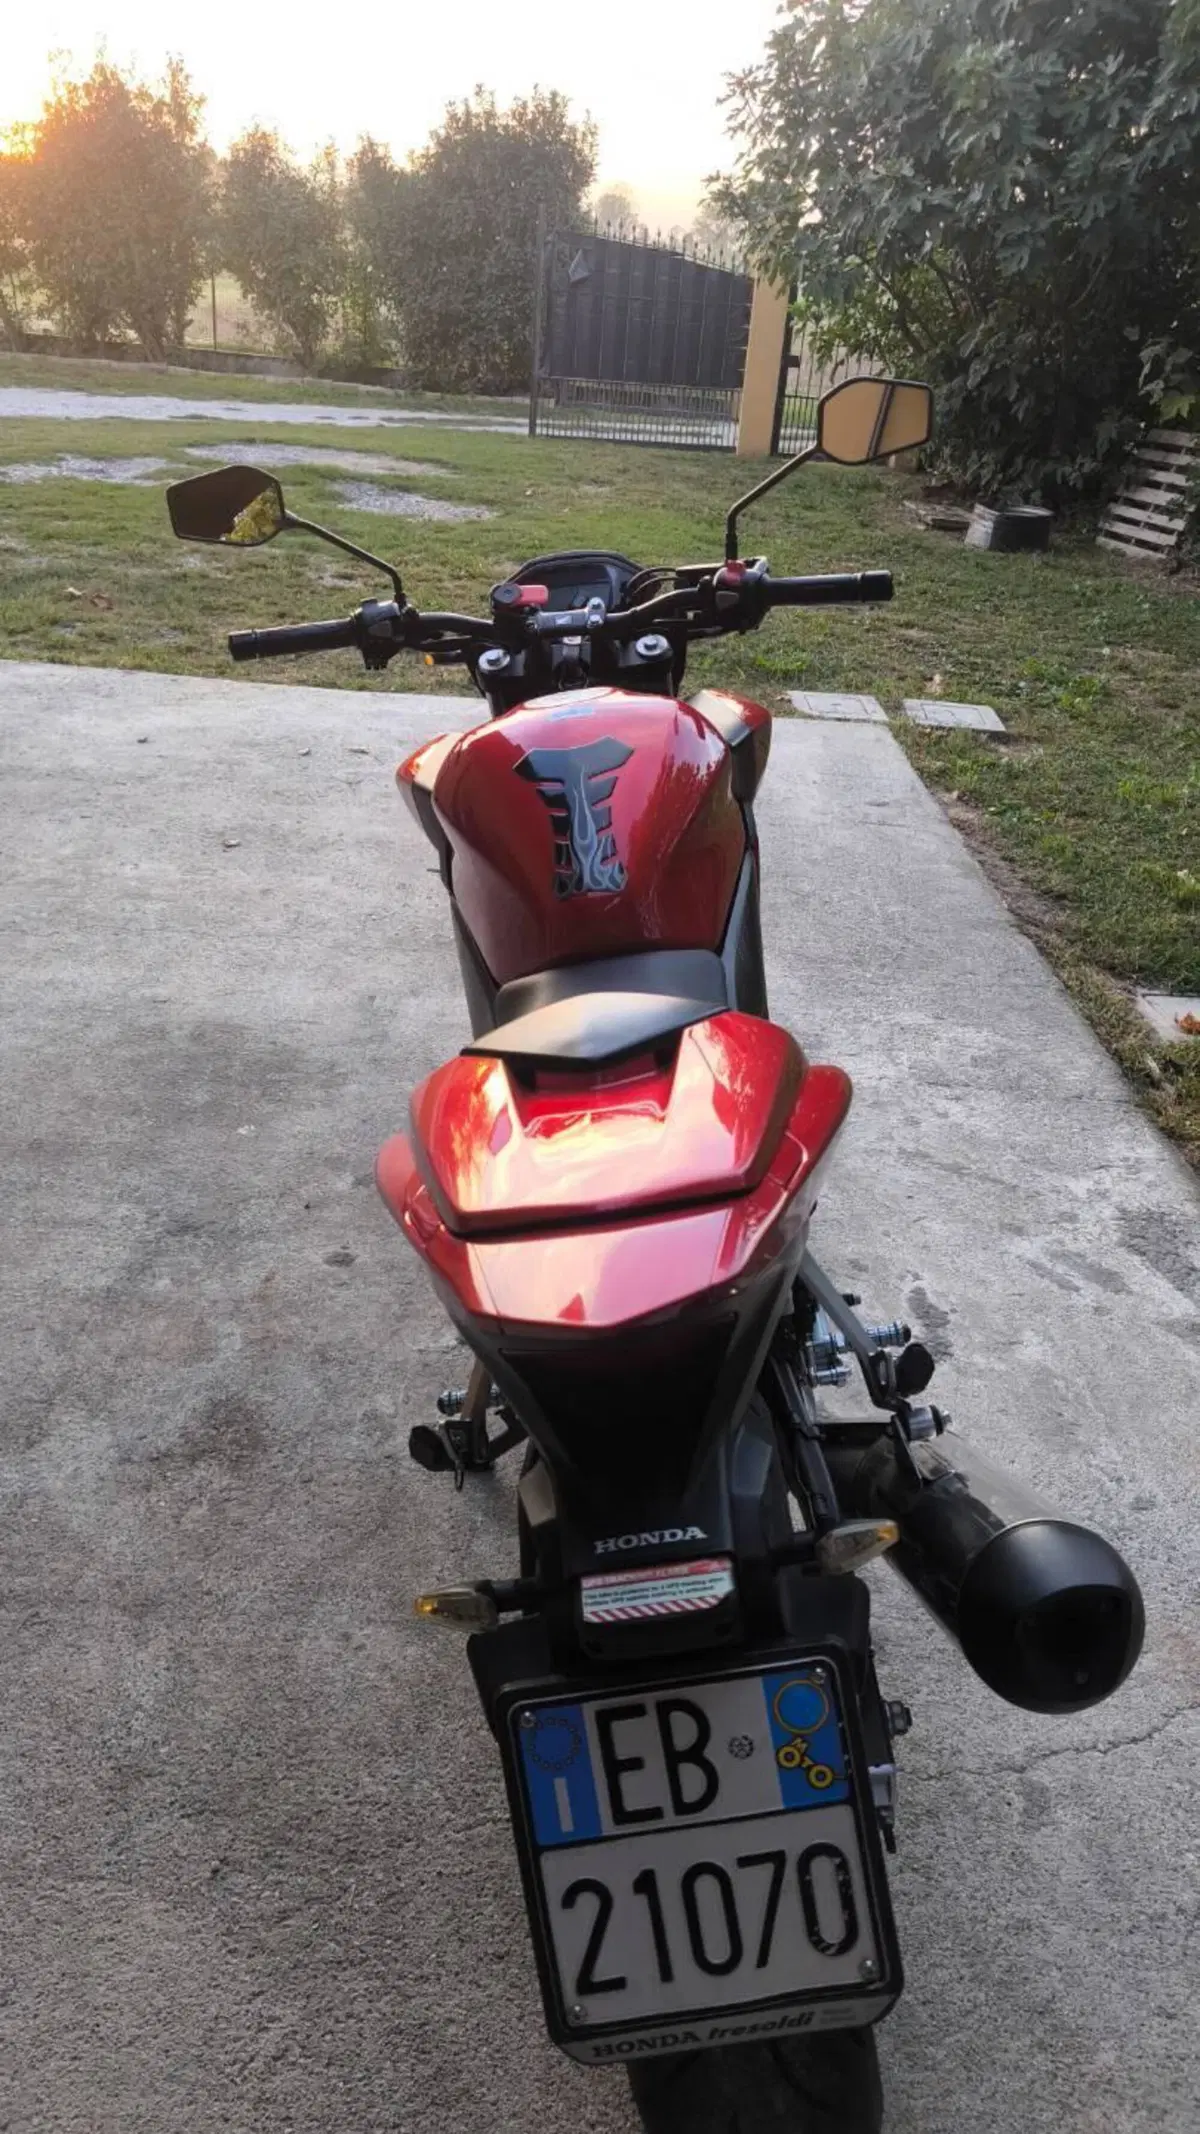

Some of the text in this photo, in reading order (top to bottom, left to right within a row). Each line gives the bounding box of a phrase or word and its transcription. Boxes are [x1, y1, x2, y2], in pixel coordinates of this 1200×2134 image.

[594, 1526, 708, 1554] HONDA
[594, 1698, 720, 1826] EB
[561, 1842, 859, 1996] 21070
[592, 2030, 701, 2058] HONDA
